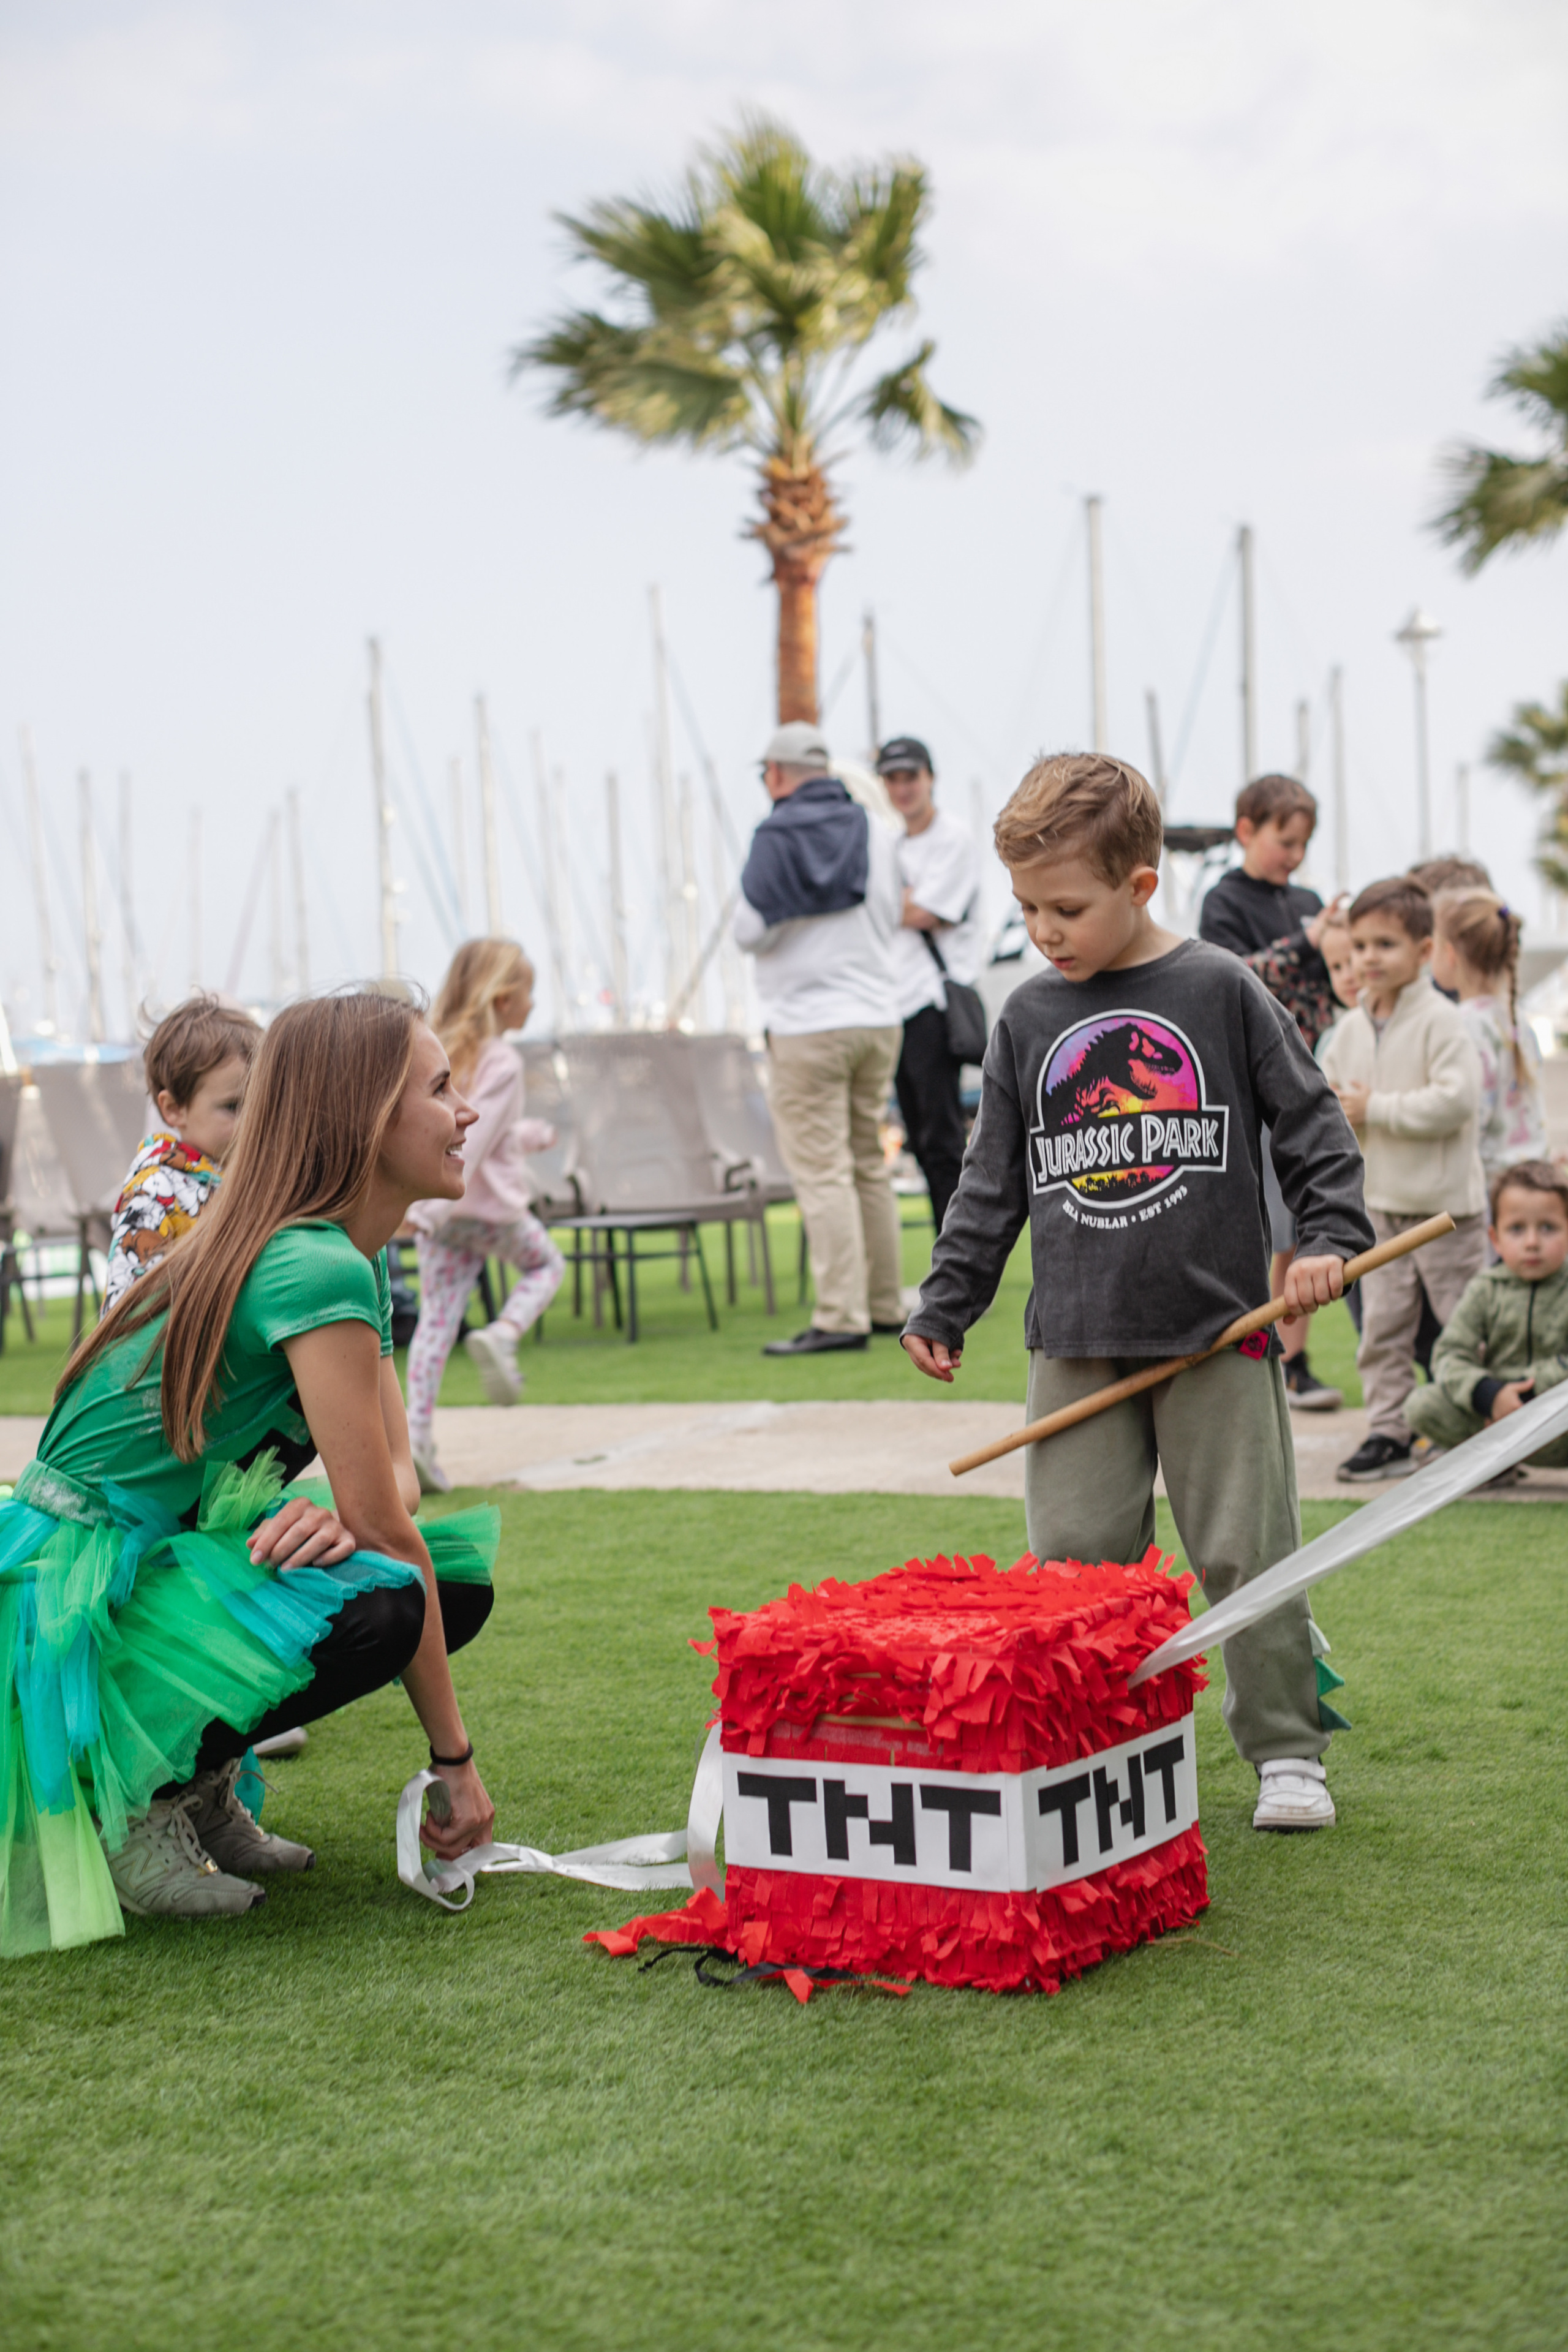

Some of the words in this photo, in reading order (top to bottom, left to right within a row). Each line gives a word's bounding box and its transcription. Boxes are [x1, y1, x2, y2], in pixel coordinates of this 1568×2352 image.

[1036, 1122, 1135, 1184] JURASSIC
[1140, 1114, 1219, 1163] PARK
[1080, 1213, 1128, 1229] NUBLAR
[1139, 1201, 1162, 1222] EST
[737, 1771, 1001, 1873] TNT
[1038, 1735, 1185, 1868] TNT
